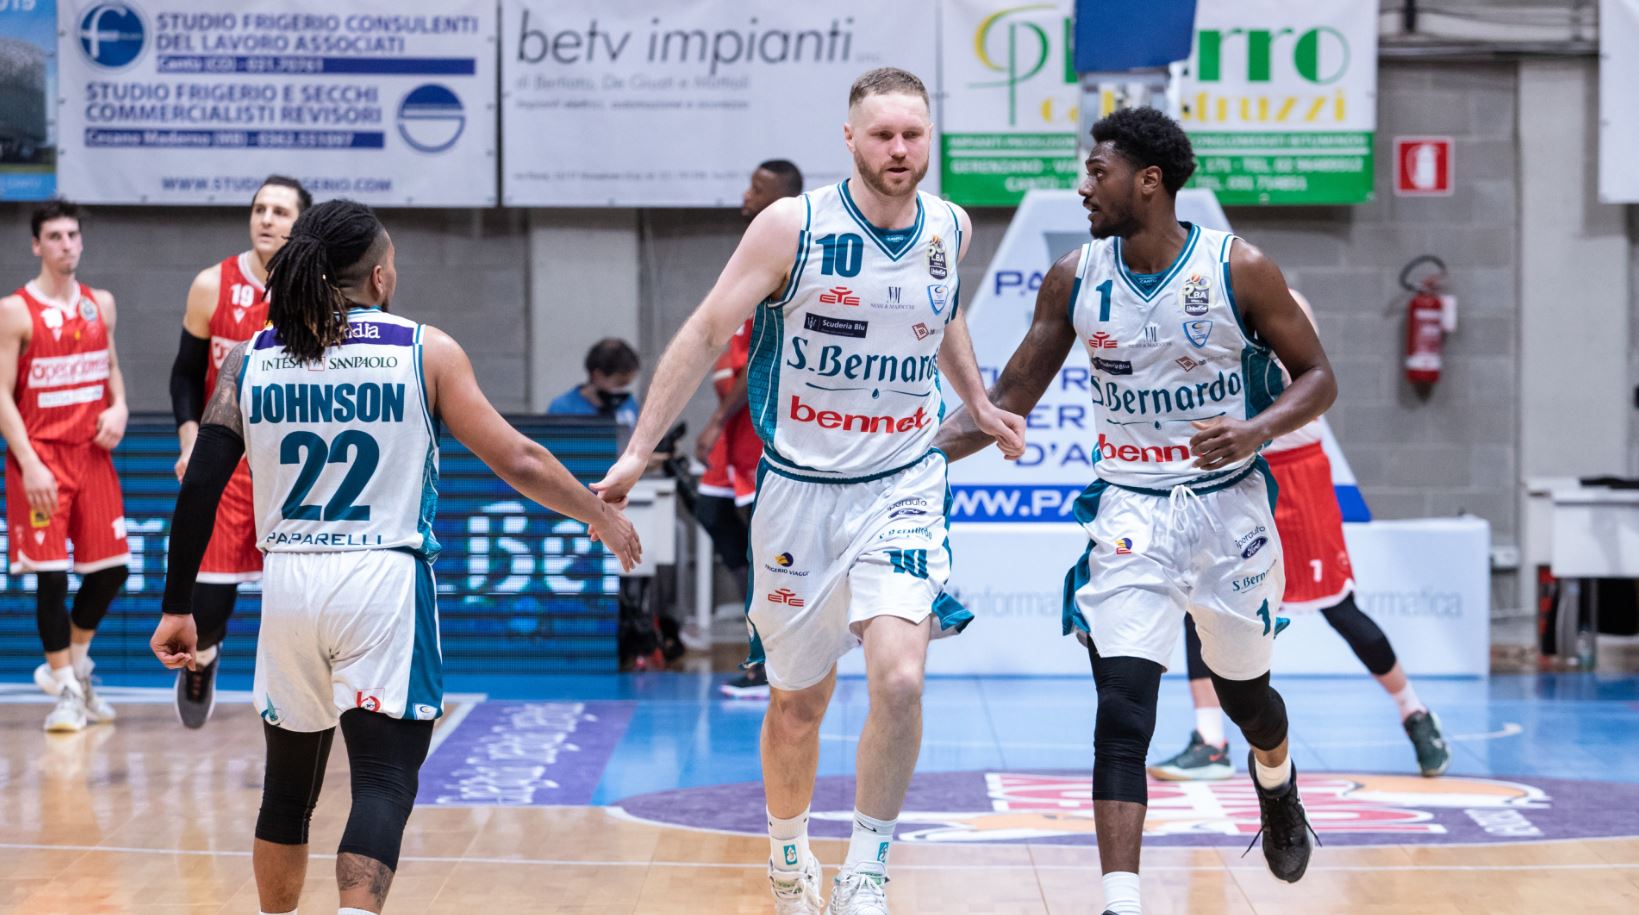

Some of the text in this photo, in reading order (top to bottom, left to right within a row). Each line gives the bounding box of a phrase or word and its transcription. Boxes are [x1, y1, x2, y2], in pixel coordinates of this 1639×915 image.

[157, 12, 479, 34] STUDIO FRIGERIO CONSULENTI
[157, 34, 405, 52] DEL LAVORO ASSOCIATI
[516, 8, 855, 76] betv impianti
[85, 82, 378, 103] STUDIO FRIGERIO E SECCHI
[85, 103, 382, 123] COMMERCIALISTI REVISORI
[816, 233, 864, 278] 10
[230, 283, 254, 308] 19
[1096, 280, 1113, 322] 1
[822, 319, 866, 331] Scuderia Blu
[261, 356, 398, 372] INTESA SANPAOLO
[249, 382, 406, 425] JOHNSON
[790, 395, 932, 433] bennet
[1098, 433, 1190, 463] benn
[280, 429, 380, 521] 22
[266, 532, 382, 546] PAPARELLI
[1257, 598, 1271, 637] 1
